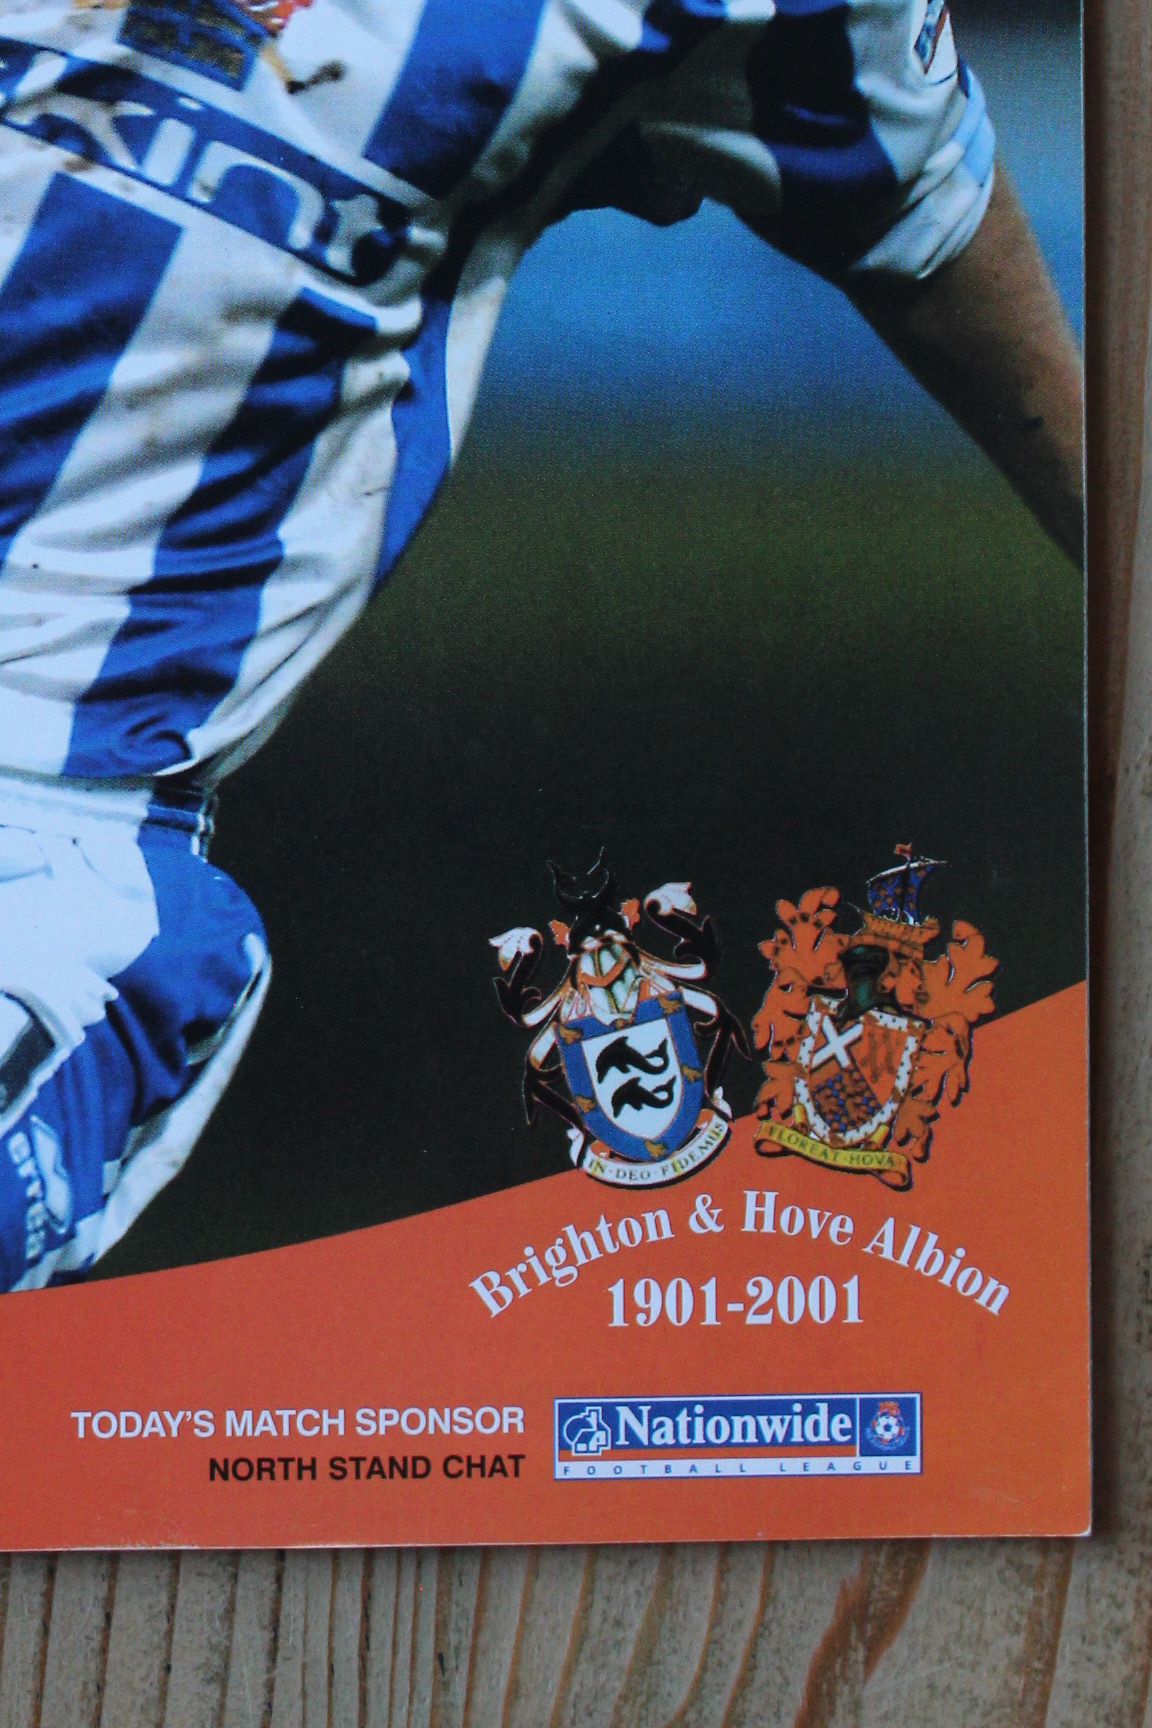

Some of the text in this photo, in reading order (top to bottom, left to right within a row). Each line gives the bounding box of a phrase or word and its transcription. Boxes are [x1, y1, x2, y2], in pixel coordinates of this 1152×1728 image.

[849, 1154, 896, 1167] HOVA
[468, 1190, 1011, 1318] Brighton & Hove Albion
[607, 1274, 863, 1327] 1901-2001
[70, 1406, 525, 1439] TODAY'S MATCH SPONSOR
[615, 1402, 852, 1446] Nationwide
[209, 1454, 526, 1482] NORTH STAND CHAT
